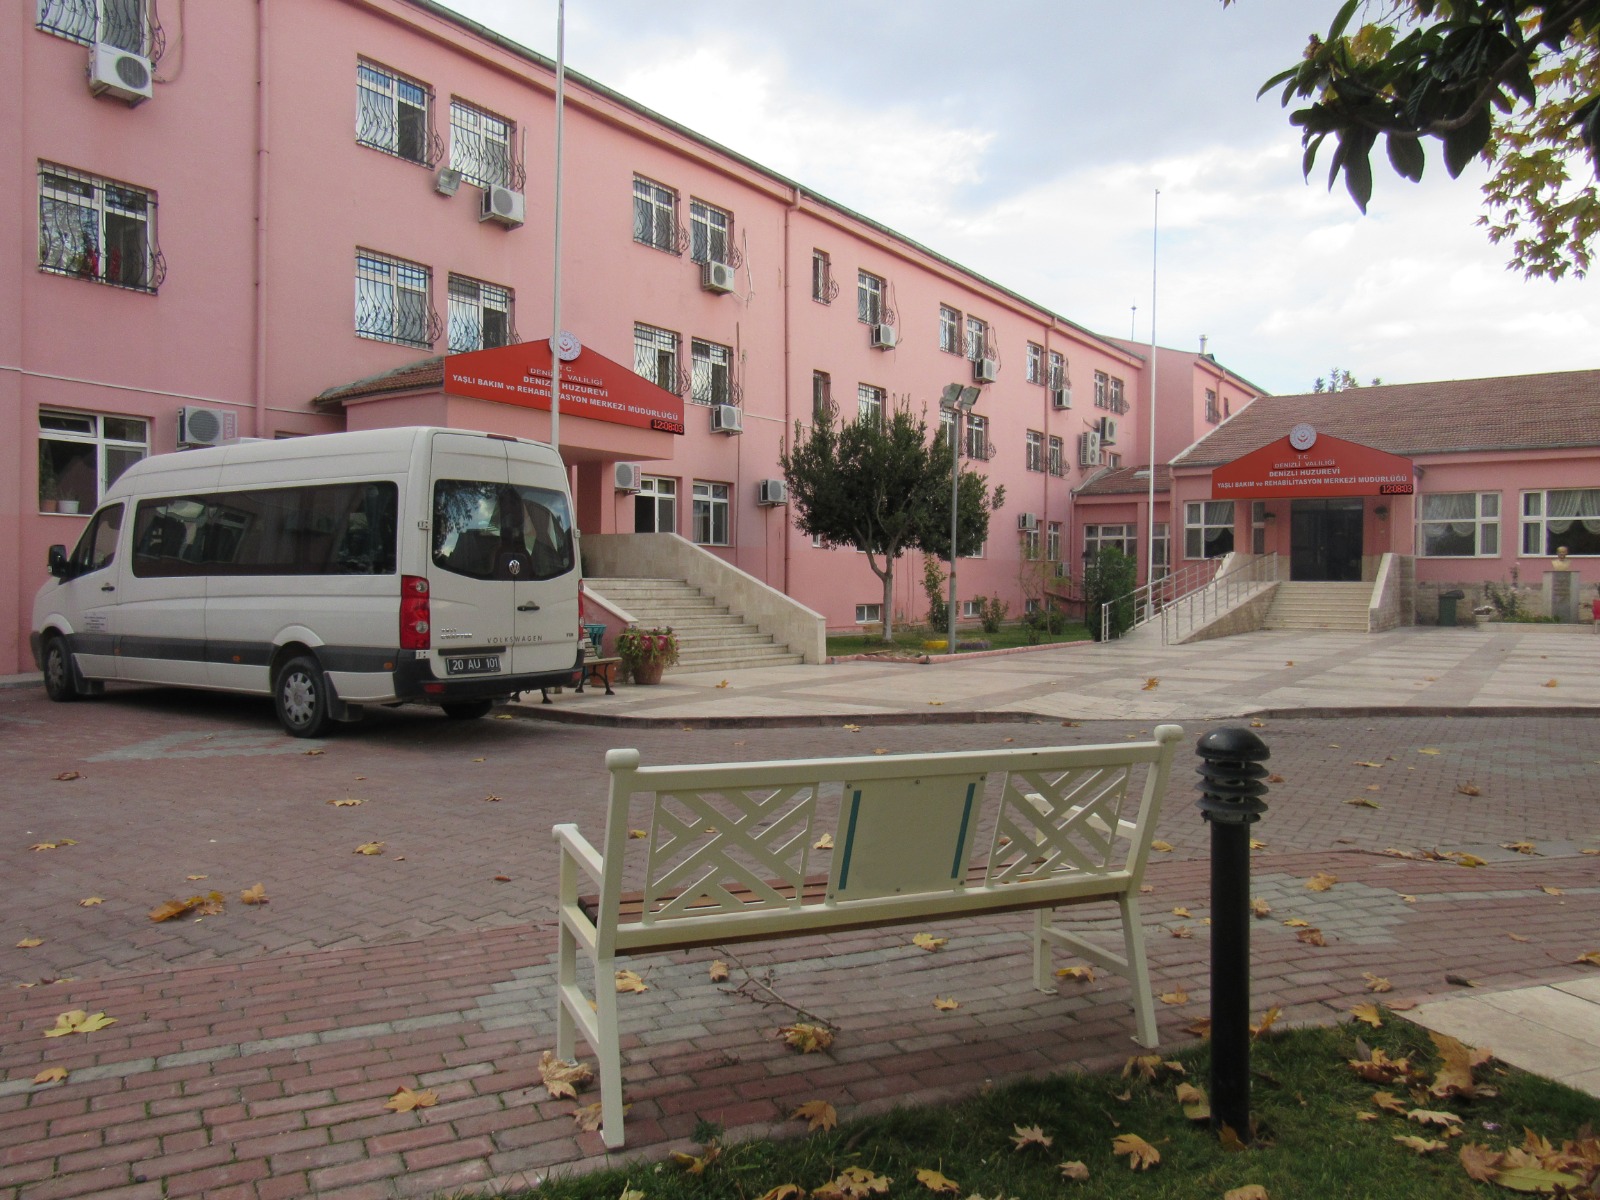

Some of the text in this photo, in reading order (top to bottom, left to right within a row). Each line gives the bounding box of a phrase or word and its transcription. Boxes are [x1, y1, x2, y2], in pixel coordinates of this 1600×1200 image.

[523, 376, 608, 397] DENİZ HUZUREVİ
[452, 374, 475, 384] YAŞLI
[477, 378, 504, 389] BAKIM
[517, 385, 587, 404] REHABİLASYON
[590, 398, 626, 411] MERKEZİ
[1300, 467, 1340, 476] HUZUREVİ
[1264, 478, 1321, 487] REHABİLİTASYON
[487, 635, 543, 644] VOLKSWAGEN
[452, 657, 498, 670] 20 AU 101
